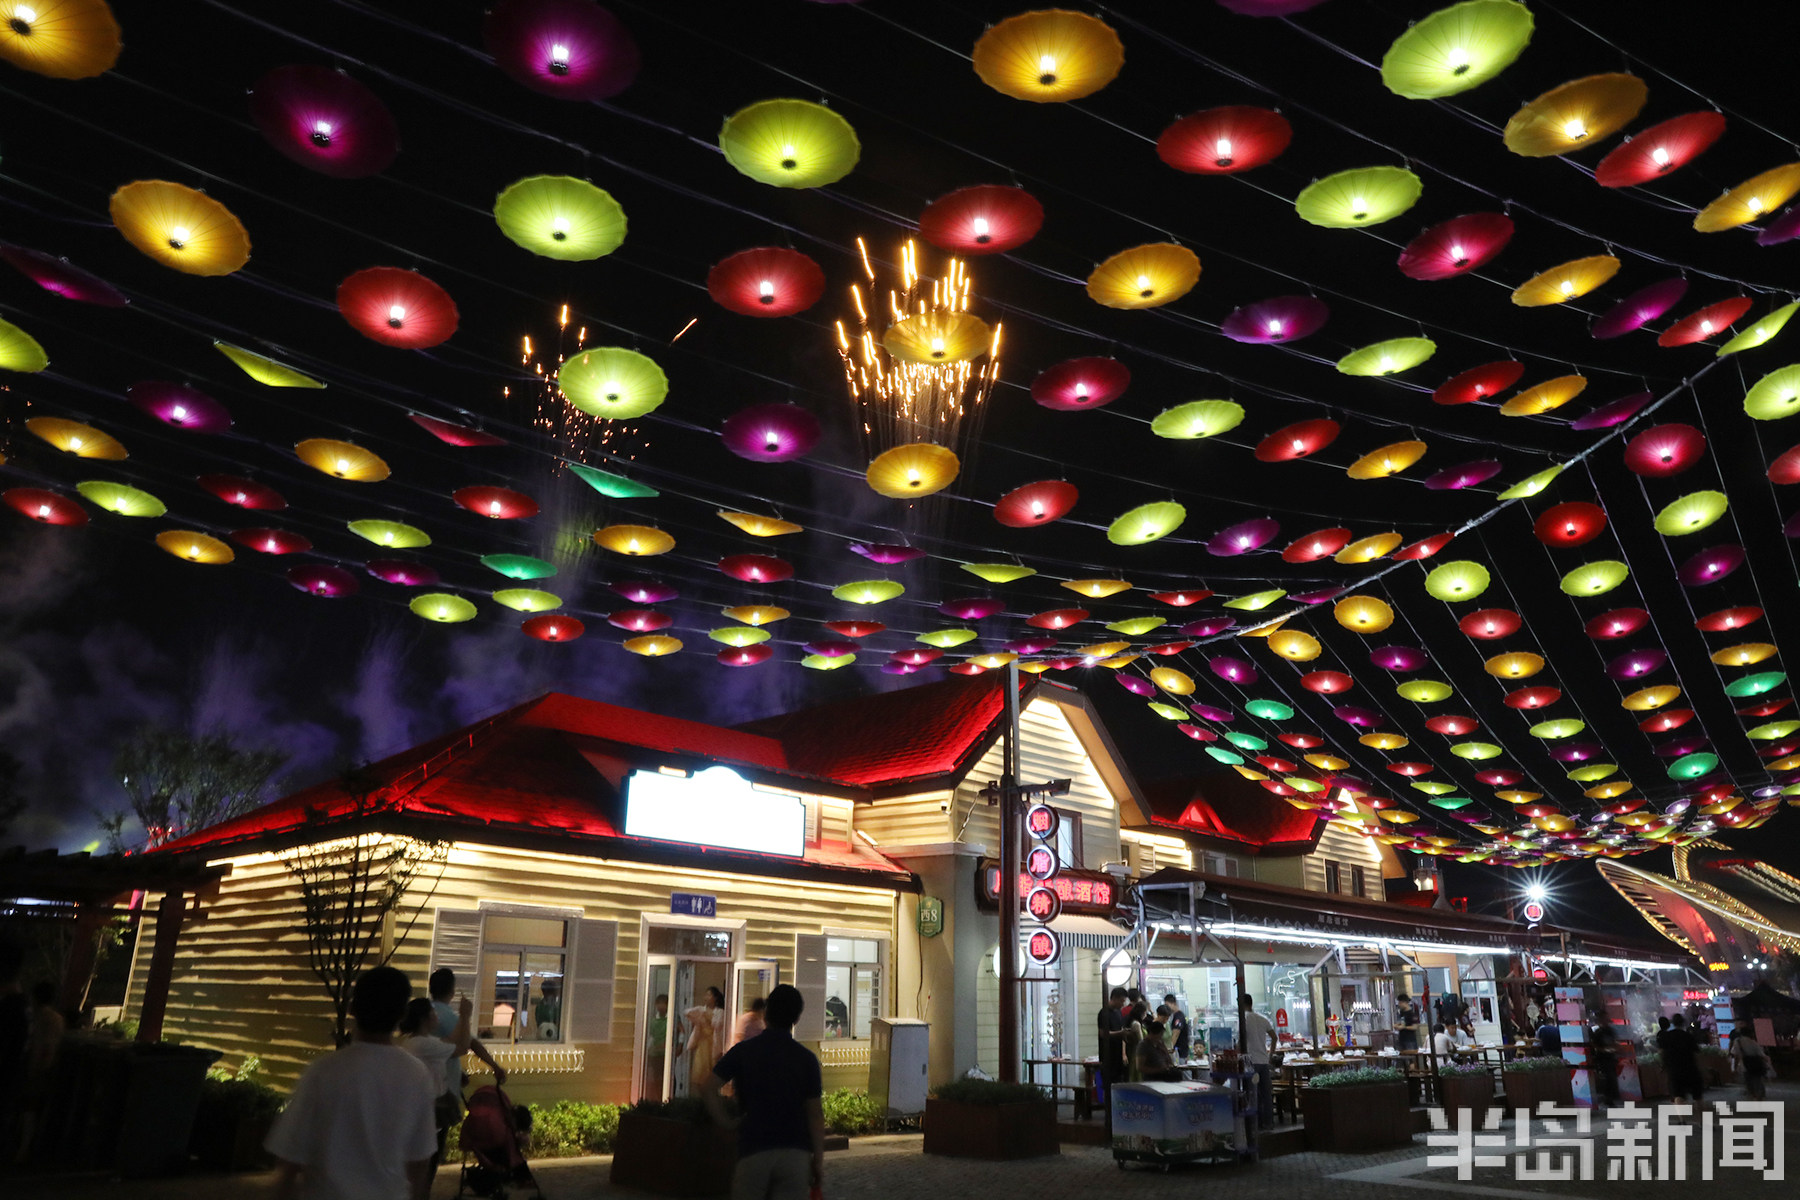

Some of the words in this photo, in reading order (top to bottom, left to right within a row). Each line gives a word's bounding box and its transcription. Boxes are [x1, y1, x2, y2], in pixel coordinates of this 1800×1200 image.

[993, 869, 1110, 905] 脂酿酒馆
[1029, 810, 1052, 957] 胭脂精酿
